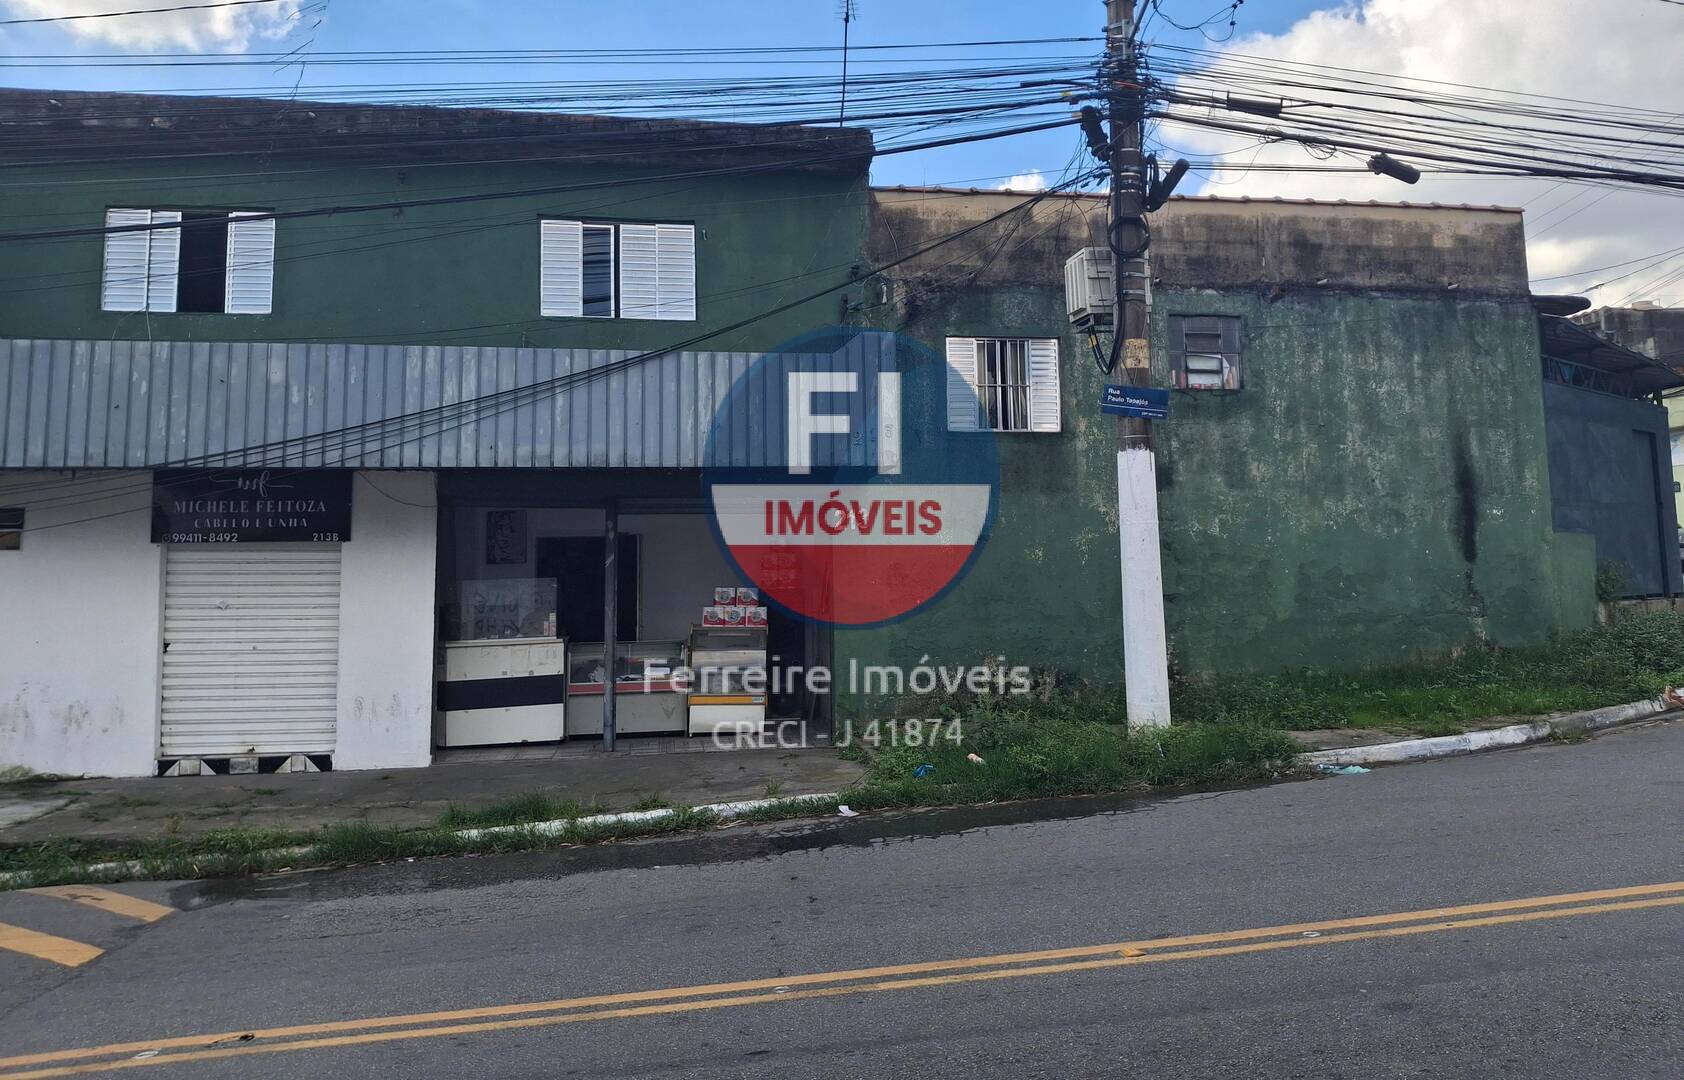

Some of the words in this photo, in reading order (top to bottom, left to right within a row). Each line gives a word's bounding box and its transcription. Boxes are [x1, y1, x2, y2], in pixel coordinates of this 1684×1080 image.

[1107, 395, 1125, 403] Paulo
[174, 500, 249, 513] MICHELE
[256, 499, 327, 513] FEITOZA
[194, 517, 250, 529] CABELO
[268, 516, 308, 528] UNHA
[172, 532, 239, 543] 99411-8492
[312, 532, 339, 542] 213B
